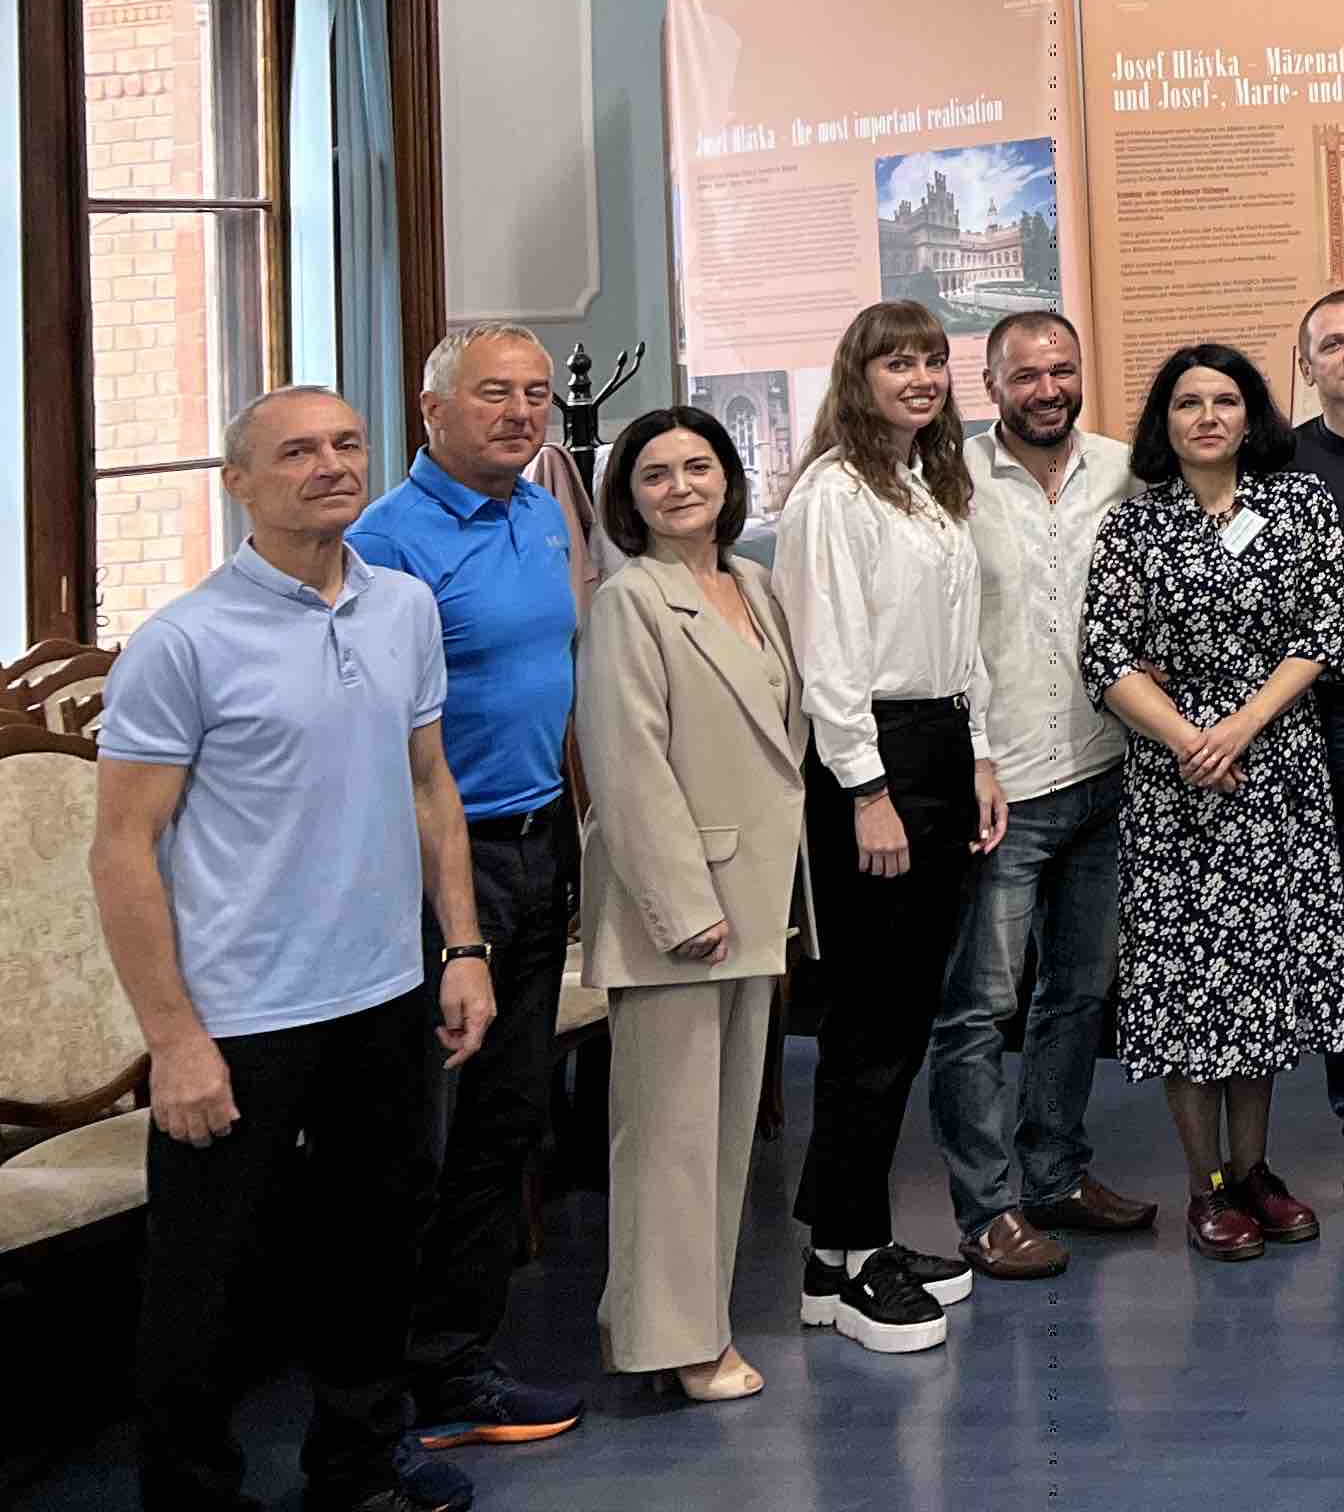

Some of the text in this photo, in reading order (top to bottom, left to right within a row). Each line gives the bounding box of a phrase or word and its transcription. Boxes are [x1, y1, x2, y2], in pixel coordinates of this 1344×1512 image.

[1112, 50, 1165, 81] Josef
[1173, 48, 1240, 79] Hlávka
[1113, 81, 1151, 112] und
[1234, 76, 1299, 106] Marie-
[1308, 73, 1344, 103] und
[791, 118, 813, 146] the
[818, 115, 849, 144] most
[853, 104, 921, 145] important
[927, 94, 1004, 130] realisation
